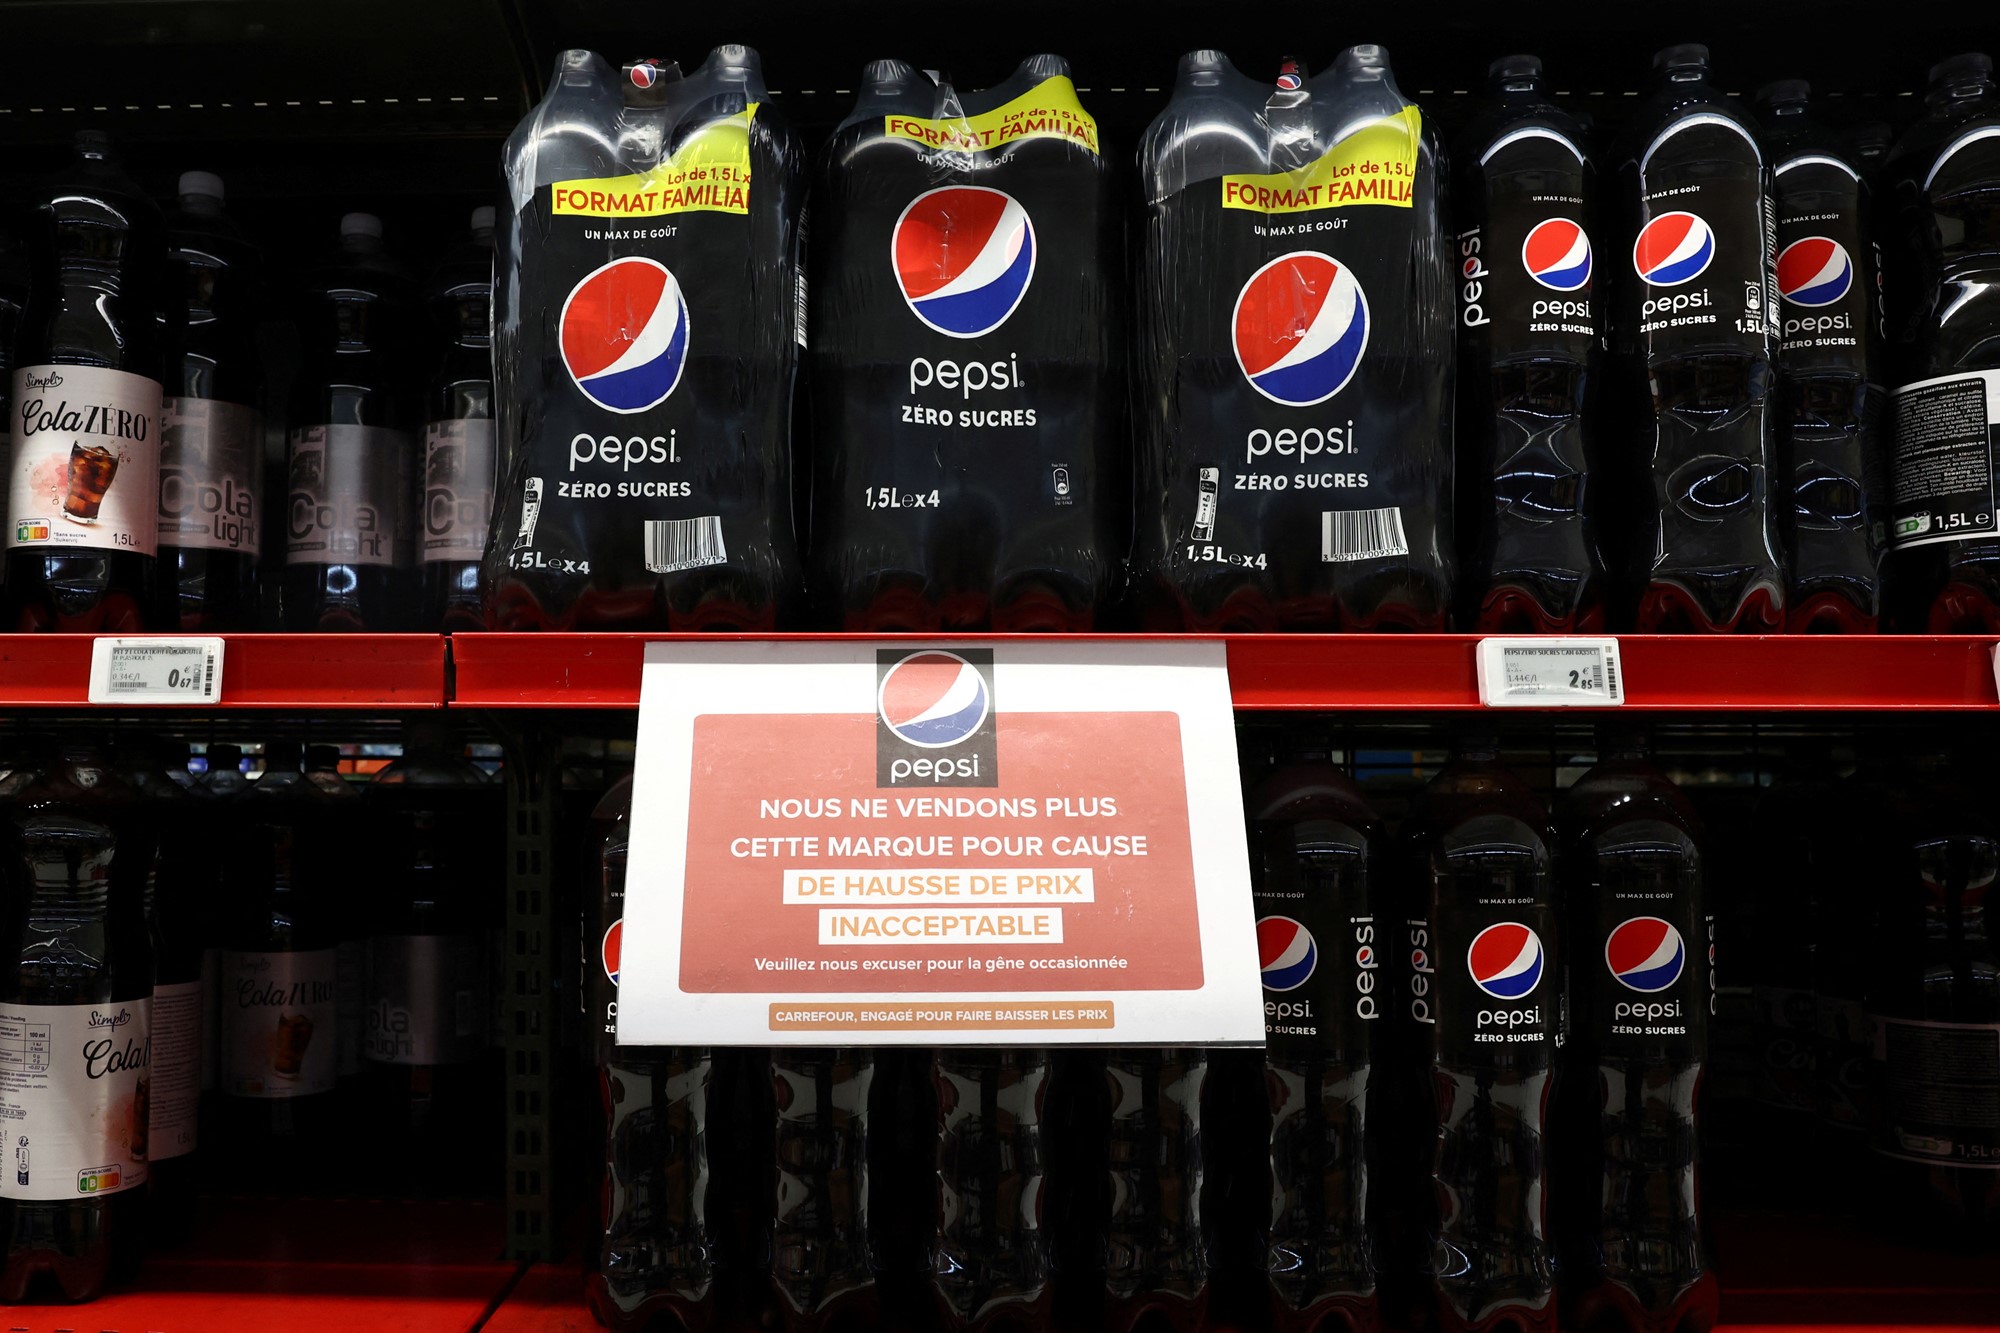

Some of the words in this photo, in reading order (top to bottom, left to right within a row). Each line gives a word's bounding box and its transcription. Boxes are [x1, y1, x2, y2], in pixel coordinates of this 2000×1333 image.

[1004, 109, 1025, 124] Lot
[1028, 108, 1048, 118] de
[890, 120, 994, 148] FORMAT
[917, 154, 932, 165] UN
[985, 154, 1015, 169] GOÛT
[1333, 165, 1356, 178] Lot
[1360, 160, 1380, 174] de
[668, 173, 686, 185] Lot
[688, 168, 706, 181] de
[556, 189, 658, 213] FORMAT
[1226, 182, 1322, 208] FORMAT
[1652, 190, 1668, 200] MAX
[1669, 188, 1678, 196] DE
[1680, 186, 1700, 194] GOÛT
[585, 229, 600, 240] UN
[604, 229, 629, 240] MAX
[632, 228, 647, 239] DE
[650, 225, 678, 238] GOÛT
[1254, 225, 1266, 236] UN
[1270, 225, 1295, 236] MAX
[1298, 224, 1312, 234] DE
[1316, 218, 1348, 232] GOÛT
[1458, 227, 1490, 327] pepsi
[1532, 300, 1590, 320] pepsi
[1642, 288, 1708, 320] pepsi
[1530, 322, 1558, 332] ZÉRO
[1561, 324, 1594, 336] SUCRES
[1640, 320, 1668, 333] ZÉRO
[1670, 314, 1716, 326] SUCRES
[1785, 312, 1850, 337] pepsi
[1782, 339, 1812, 350] ZÉRO
[1815, 338, 1856, 346] SUCRES
[910, 352, 1018, 400] pepsi
[22, 398, 82, 436] Cola
[84, 404, 146, 441] ZÉRO
[902, 404, 954, 427] ZÉRO
[959, 409, 1036, 428] SUCRES
[569, 428, 676, 472] pepsi
[1246, 420, 1353, 464] pepsi
[558, 480, 612, 498] ZÉRO
[616, 482, 692, 498] SUCRES
[1234, 472, 1288, 490] ZÉRO
[1294, 473, 1369, 489] SUCRES
[1935, 512, 1970, 530] 1,5L
[1334, 552, 1364, 562] 502110
[168, 669, 179, 687] 0
[180, 678, 191, 688] 67
[1569, 670, 1579, 688] 2
[1581, 680, 1592, 689] 85
[891, 754, 979, 784] pepsi
[760, 798, 842, 819] NOUS
[850, 799, 888, 818] NE
[896, 798, 1037, 818] VENDONS
[1046, 797, 1117, 817] PLUS
[730, 837, 818, 857] CETTE
[828, 836, 953, 858] MARQUE
[962, 836, 1043, 856] POUR
[1052, 835, 1147, 857] CAUSE
[798, 877, 834, 896] DE
[845, 875, 959, 896] HAUSSE
[970, 875, 1007, 895] DE
[1017, 875, 1082, 894] PRIX
[831, 915, 1050, 936] INACCEPTABLE
[755, 957, 815, 972] Veuillez
[820, 960, 858, 971] nous
[862, 959, 922, 971] excuser
[927, 960, 963, 972] pour
[968, 957, 981, 970] la
[986, 956, 1025, 973] gêne
[1030, 956, 1128, 970] occasionnée
[1350, 917, 1379, 1019] pepsi
[1407, 920, 1435, 1024] pepsi
[776, 1010, 858, 1023] CARREFOUR,
[861, 1008, 912, 1022] ENGAGÉ
[916, 1009, 952, 1021] POUR
[956, 1010, 992, 1020] FAIRE
[995, 1010, 1049, 1020] BAISSER
[1052, 1009, 1074, 1020] LES
[1077, 1009, 1107, 1020] PRIX
[1264, 1000, 1309, 1020] epsi
[1477, 1006, 1539, 1029] pepsi
[1615, 1000, 1680, 1021] pepsi
[1275, 1026, 1316, 1035] SUCRES
[1474, 1033, 1503, 1042] ZÉRO
[1506, 1033, 1544, 1042] SUCRES
[1612, 1025, 1642, 1034] ZÉRO
[1645, 1026, 1686, 1034] SUCRES
[83, 1039, 140, 1079] Cola
